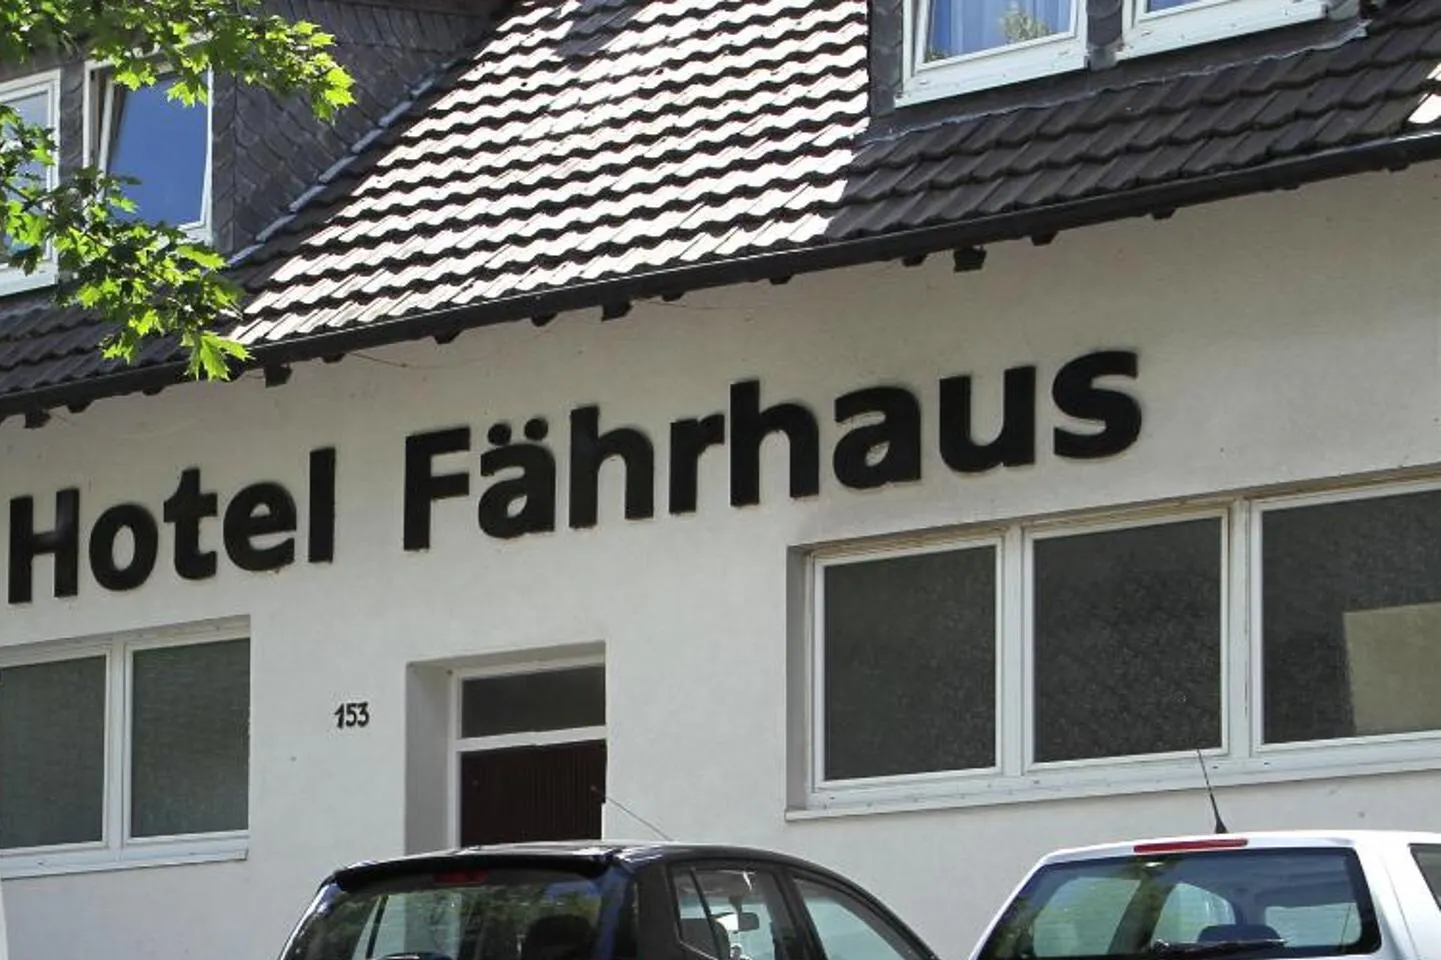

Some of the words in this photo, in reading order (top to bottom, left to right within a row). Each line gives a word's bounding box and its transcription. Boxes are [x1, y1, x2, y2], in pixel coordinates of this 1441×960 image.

[8, 446, 336, 604] Hotel
[403, 350, 1143, 551] Fährhaus
[334, 701, 370, 729] 153
